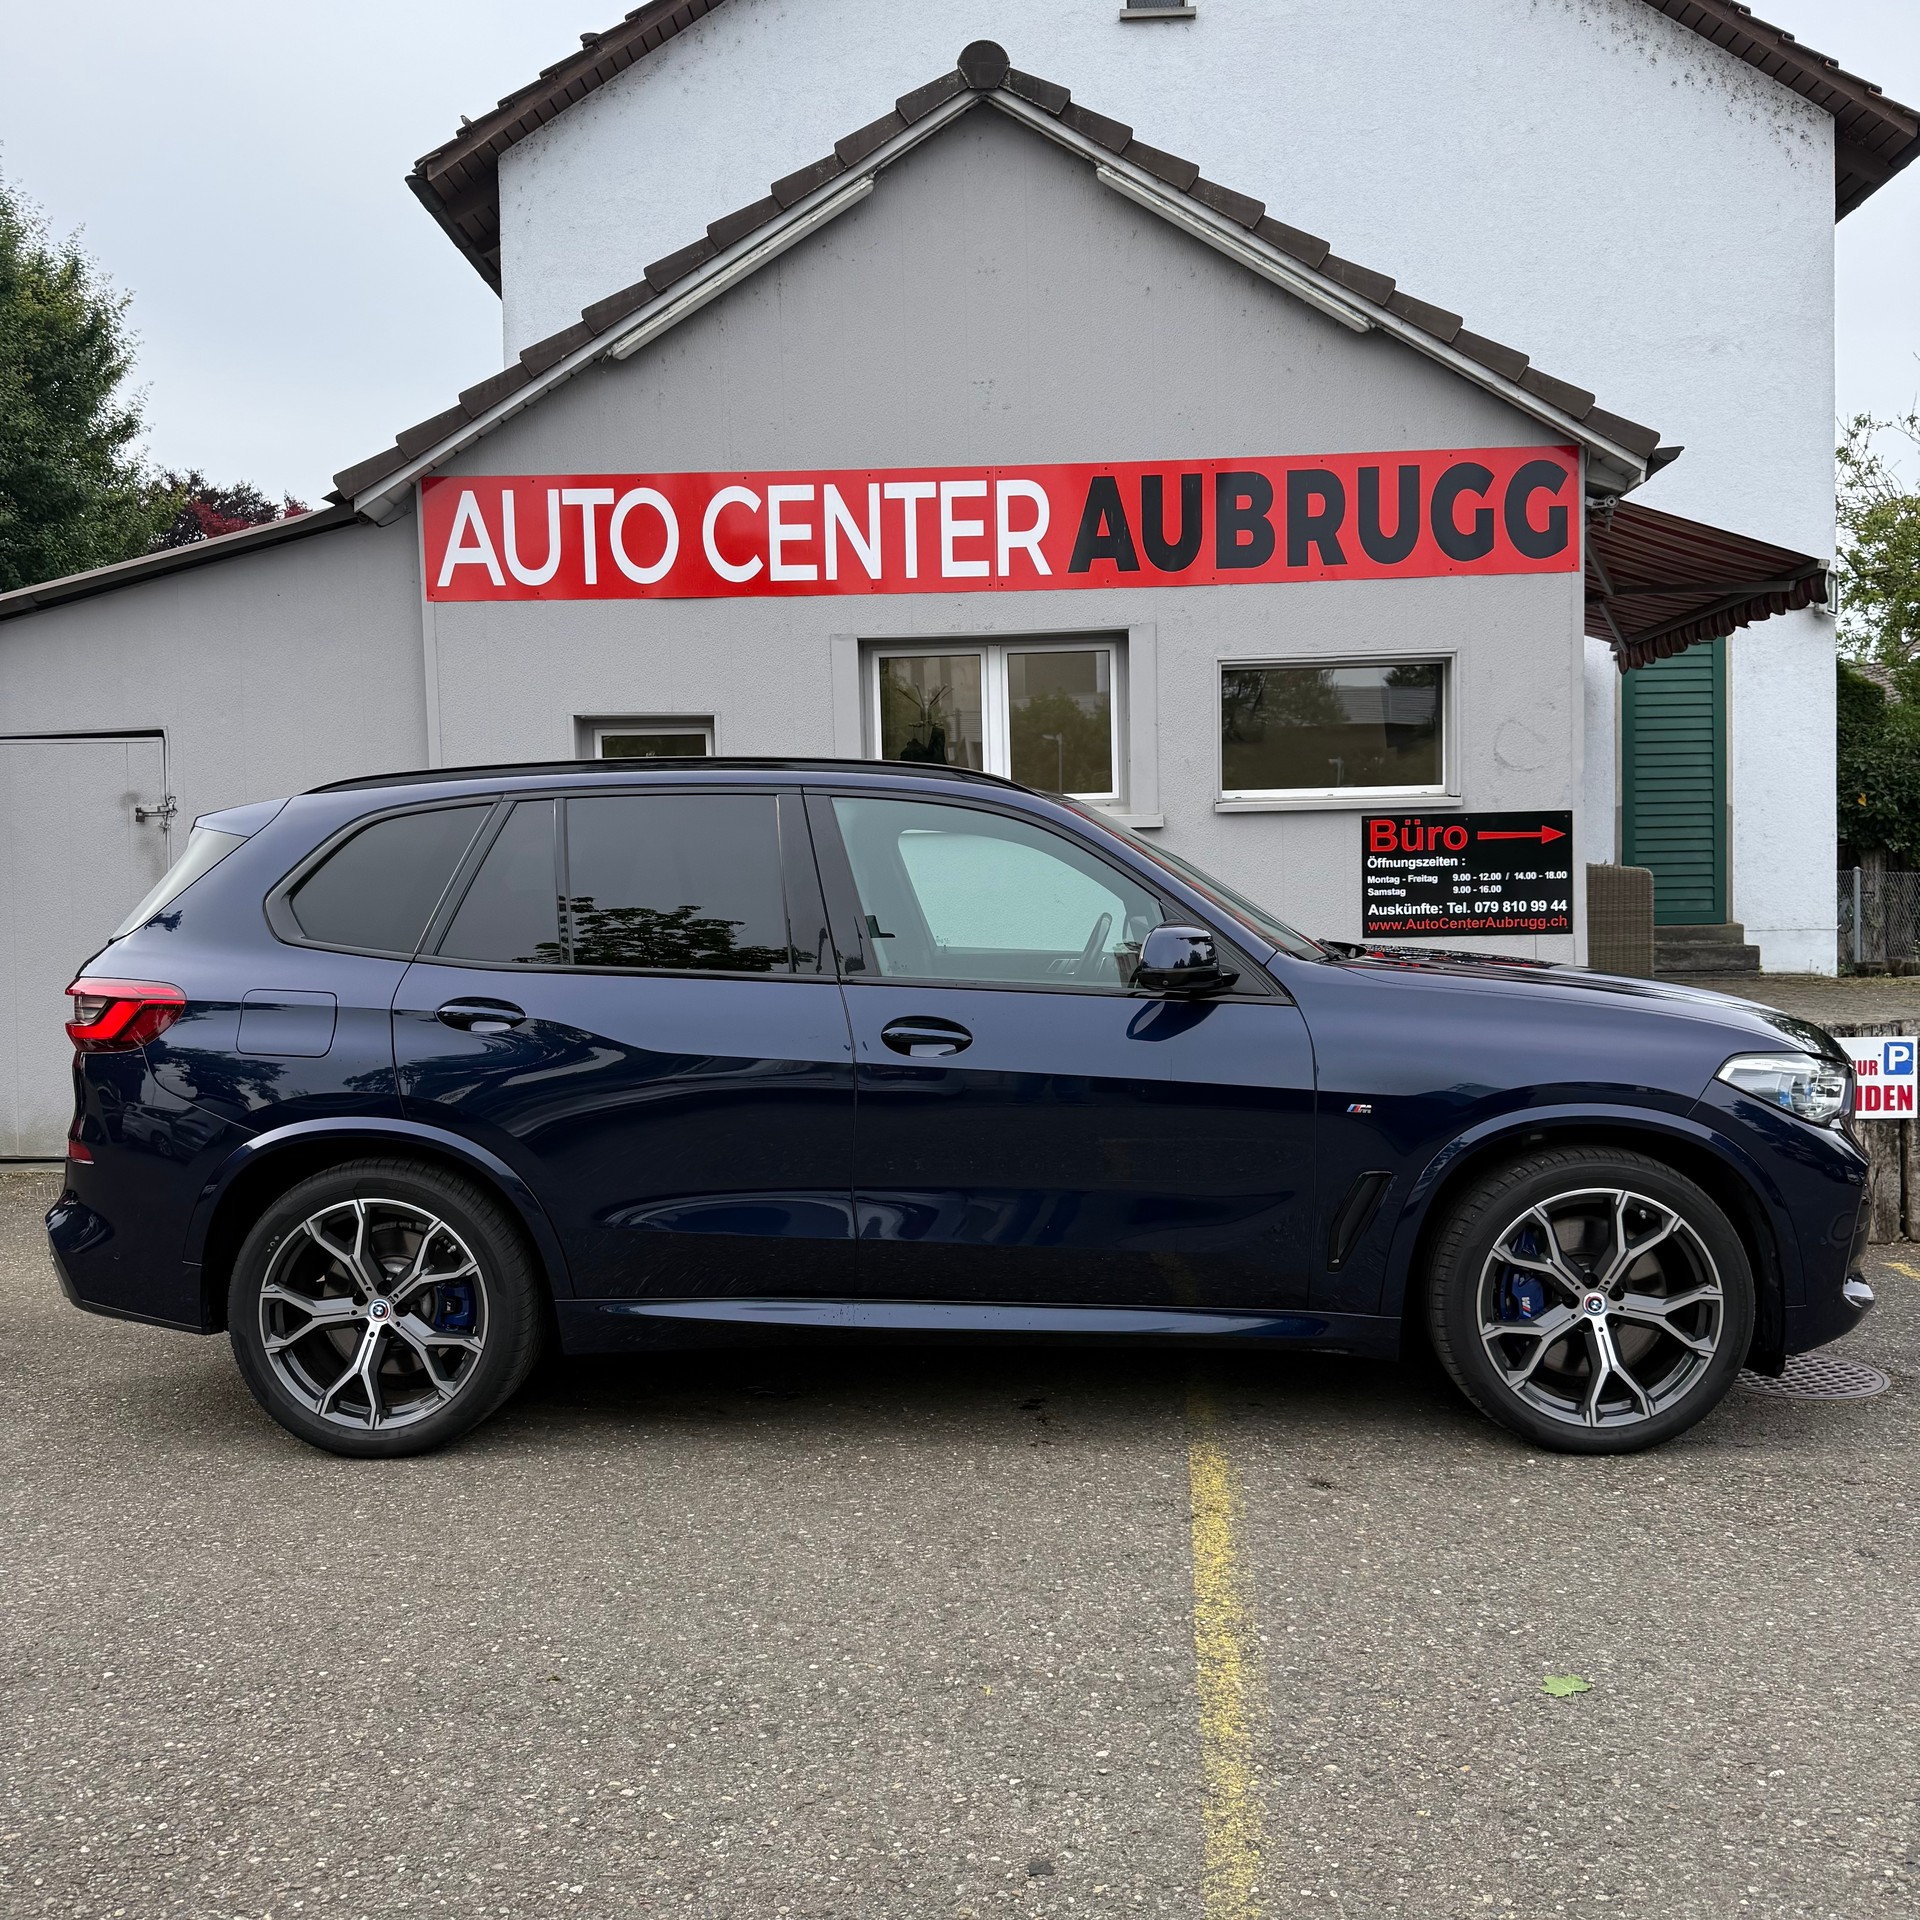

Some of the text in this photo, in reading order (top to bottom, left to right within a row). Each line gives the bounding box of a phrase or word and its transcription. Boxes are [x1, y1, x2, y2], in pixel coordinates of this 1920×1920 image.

[437, 459, 1569, 587] AUTO CENTER AUBRUGG
[1370, 819, 1468, 852] Büro
[1367, 855, 1458, 870] Öffnungszeiten
[1367, 875, 1400, 885] Montag
[1407, 874, 1438, 884] Freitag
[1452, 873, 1471, 882] 9.00
[1479, 872, 1502, 881] 12.00
[1514, 871, 1537, 880] 14.00
[1545, 870, 1568, 880] 18.00
[1368, 888, 1407, 898] Samstag
[1452, 885, 1471, 894] 9.00
[1479, 885, 1502, 893] 16.00
[1368, 899, 1568, 916] Auskünfte: Tel. 079 810 99 44
[1368, 915, 1567, 931] www.AutoCenterAubrugg.ch
[1889, 1045, 1910, 1071] P
[1853, 1059, 1878, 1076] UR
